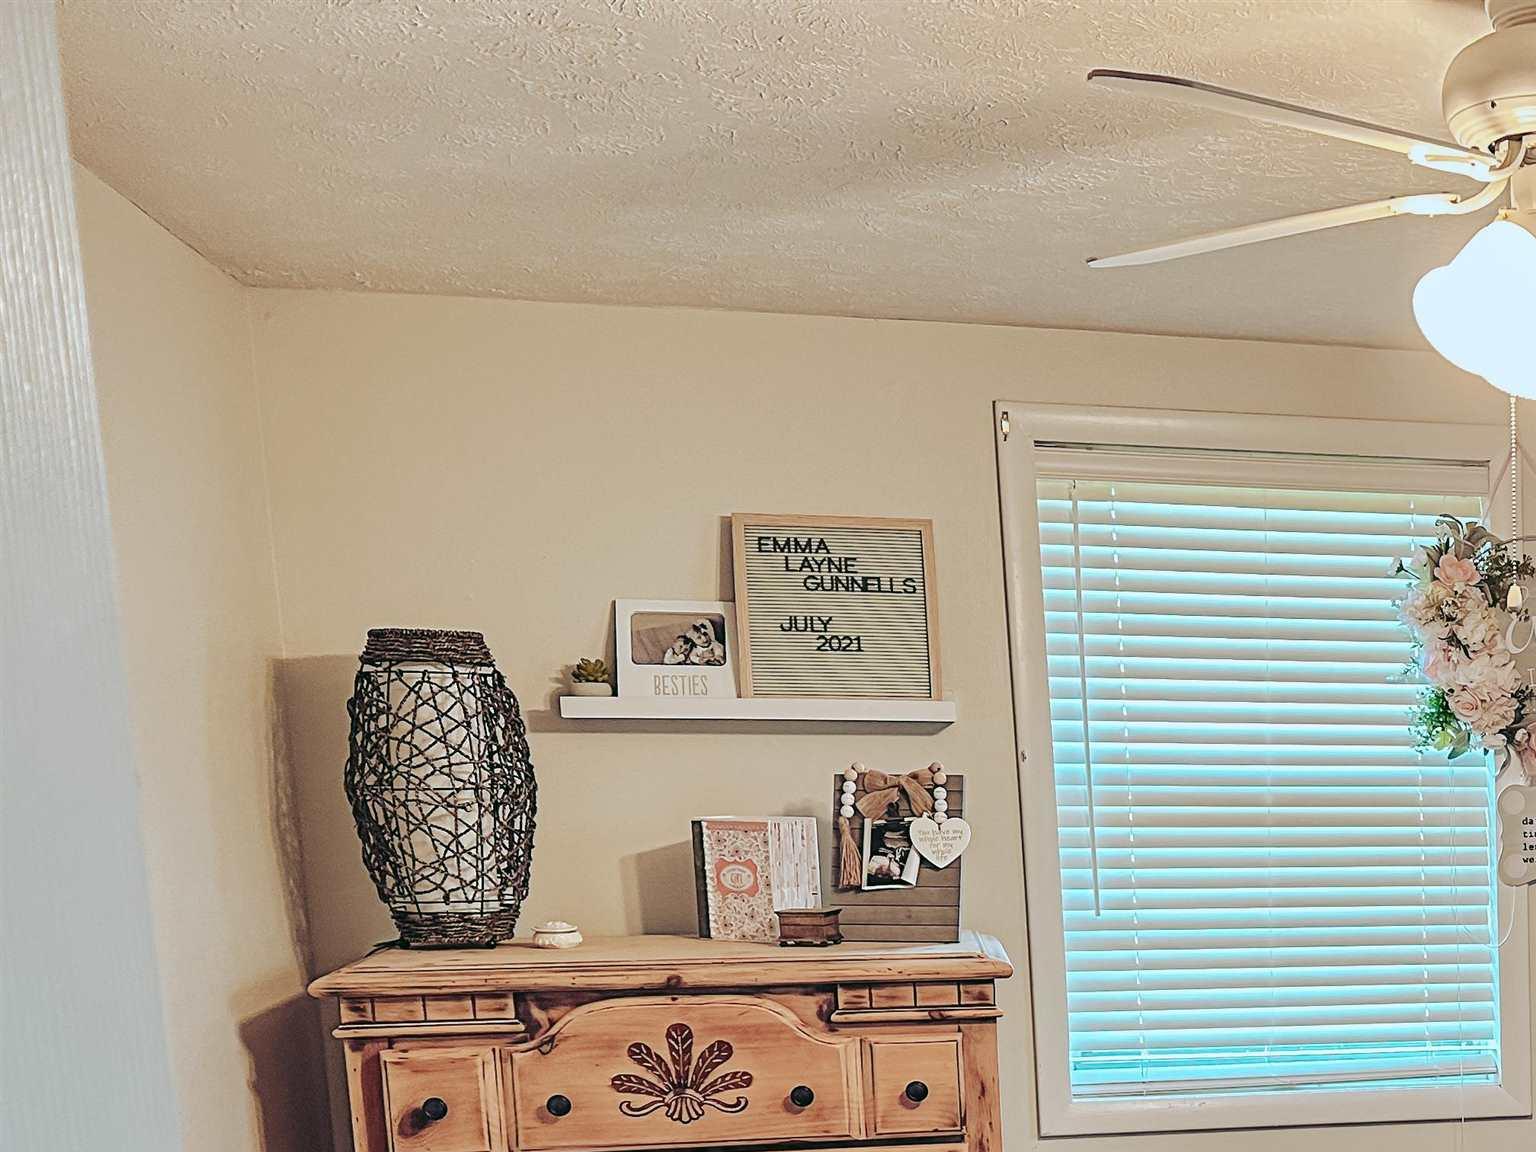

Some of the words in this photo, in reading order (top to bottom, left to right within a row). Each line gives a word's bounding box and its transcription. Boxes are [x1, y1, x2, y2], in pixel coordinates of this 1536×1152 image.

[757, 536, 831, 555] EMMA
[784, 556, 859, 575] LAYNE
[803, 575, 918, 595] GUNNELLS
[779, 615, 833, 634] JULY
[815, 635, 864, 653] 2021
[652, 674, 709, 697] BESTIES
